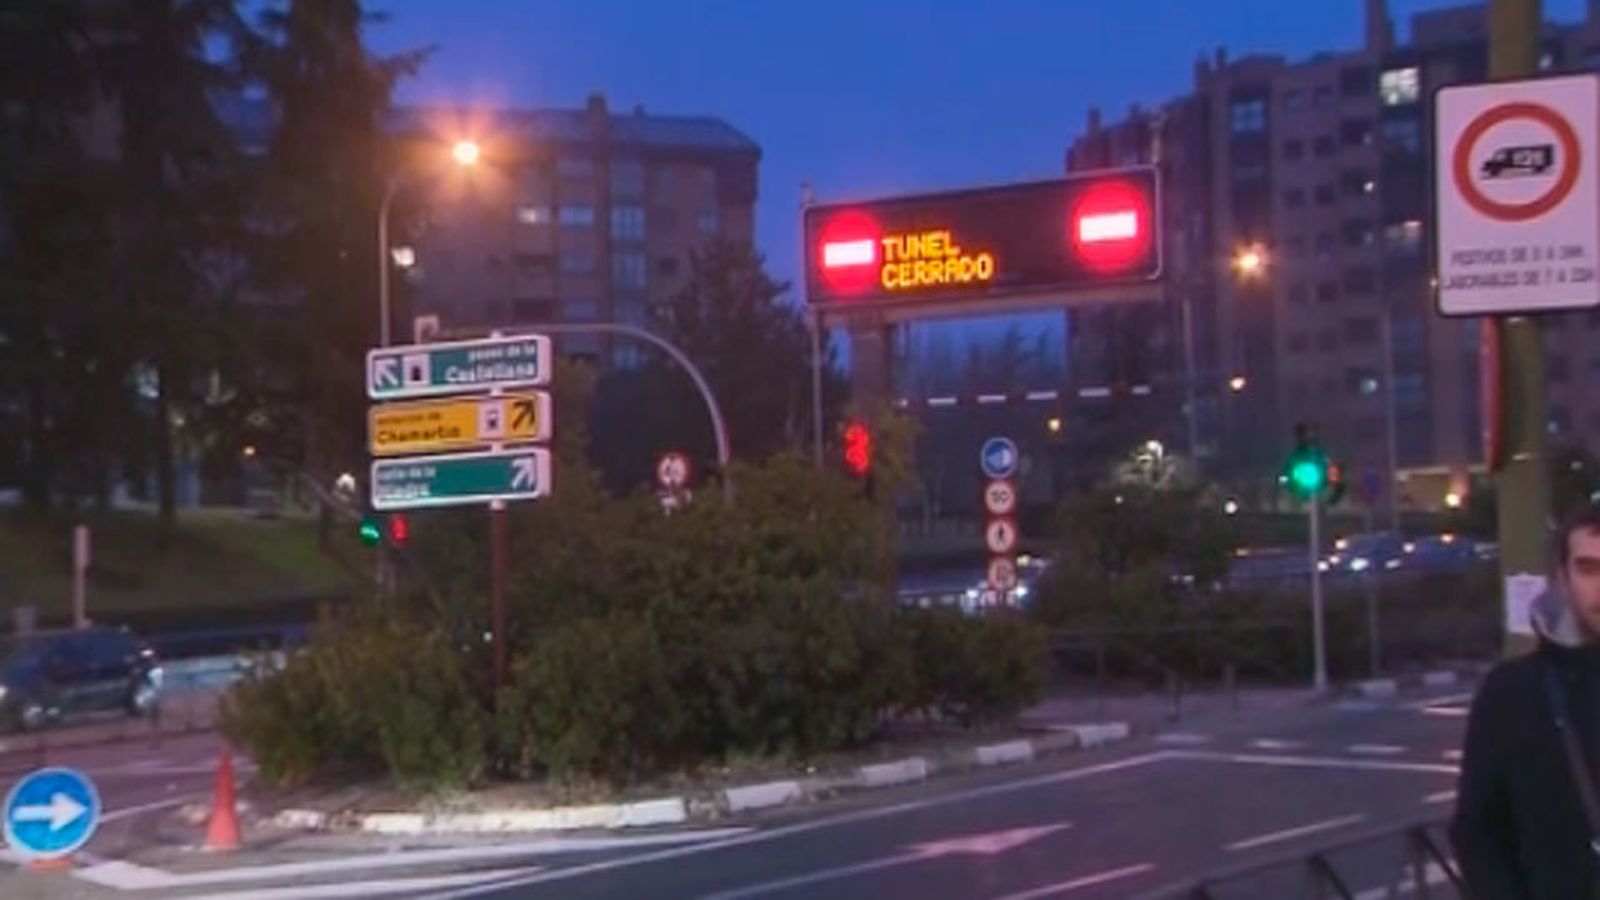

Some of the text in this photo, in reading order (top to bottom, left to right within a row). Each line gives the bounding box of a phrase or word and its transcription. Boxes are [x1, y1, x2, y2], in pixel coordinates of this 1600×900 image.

[882, 253, 993, 288] CERRADO
[506, 344, 520, 357] de
[524, 343, 535, 356] la
[444, 361, 536, 382] Castellana
